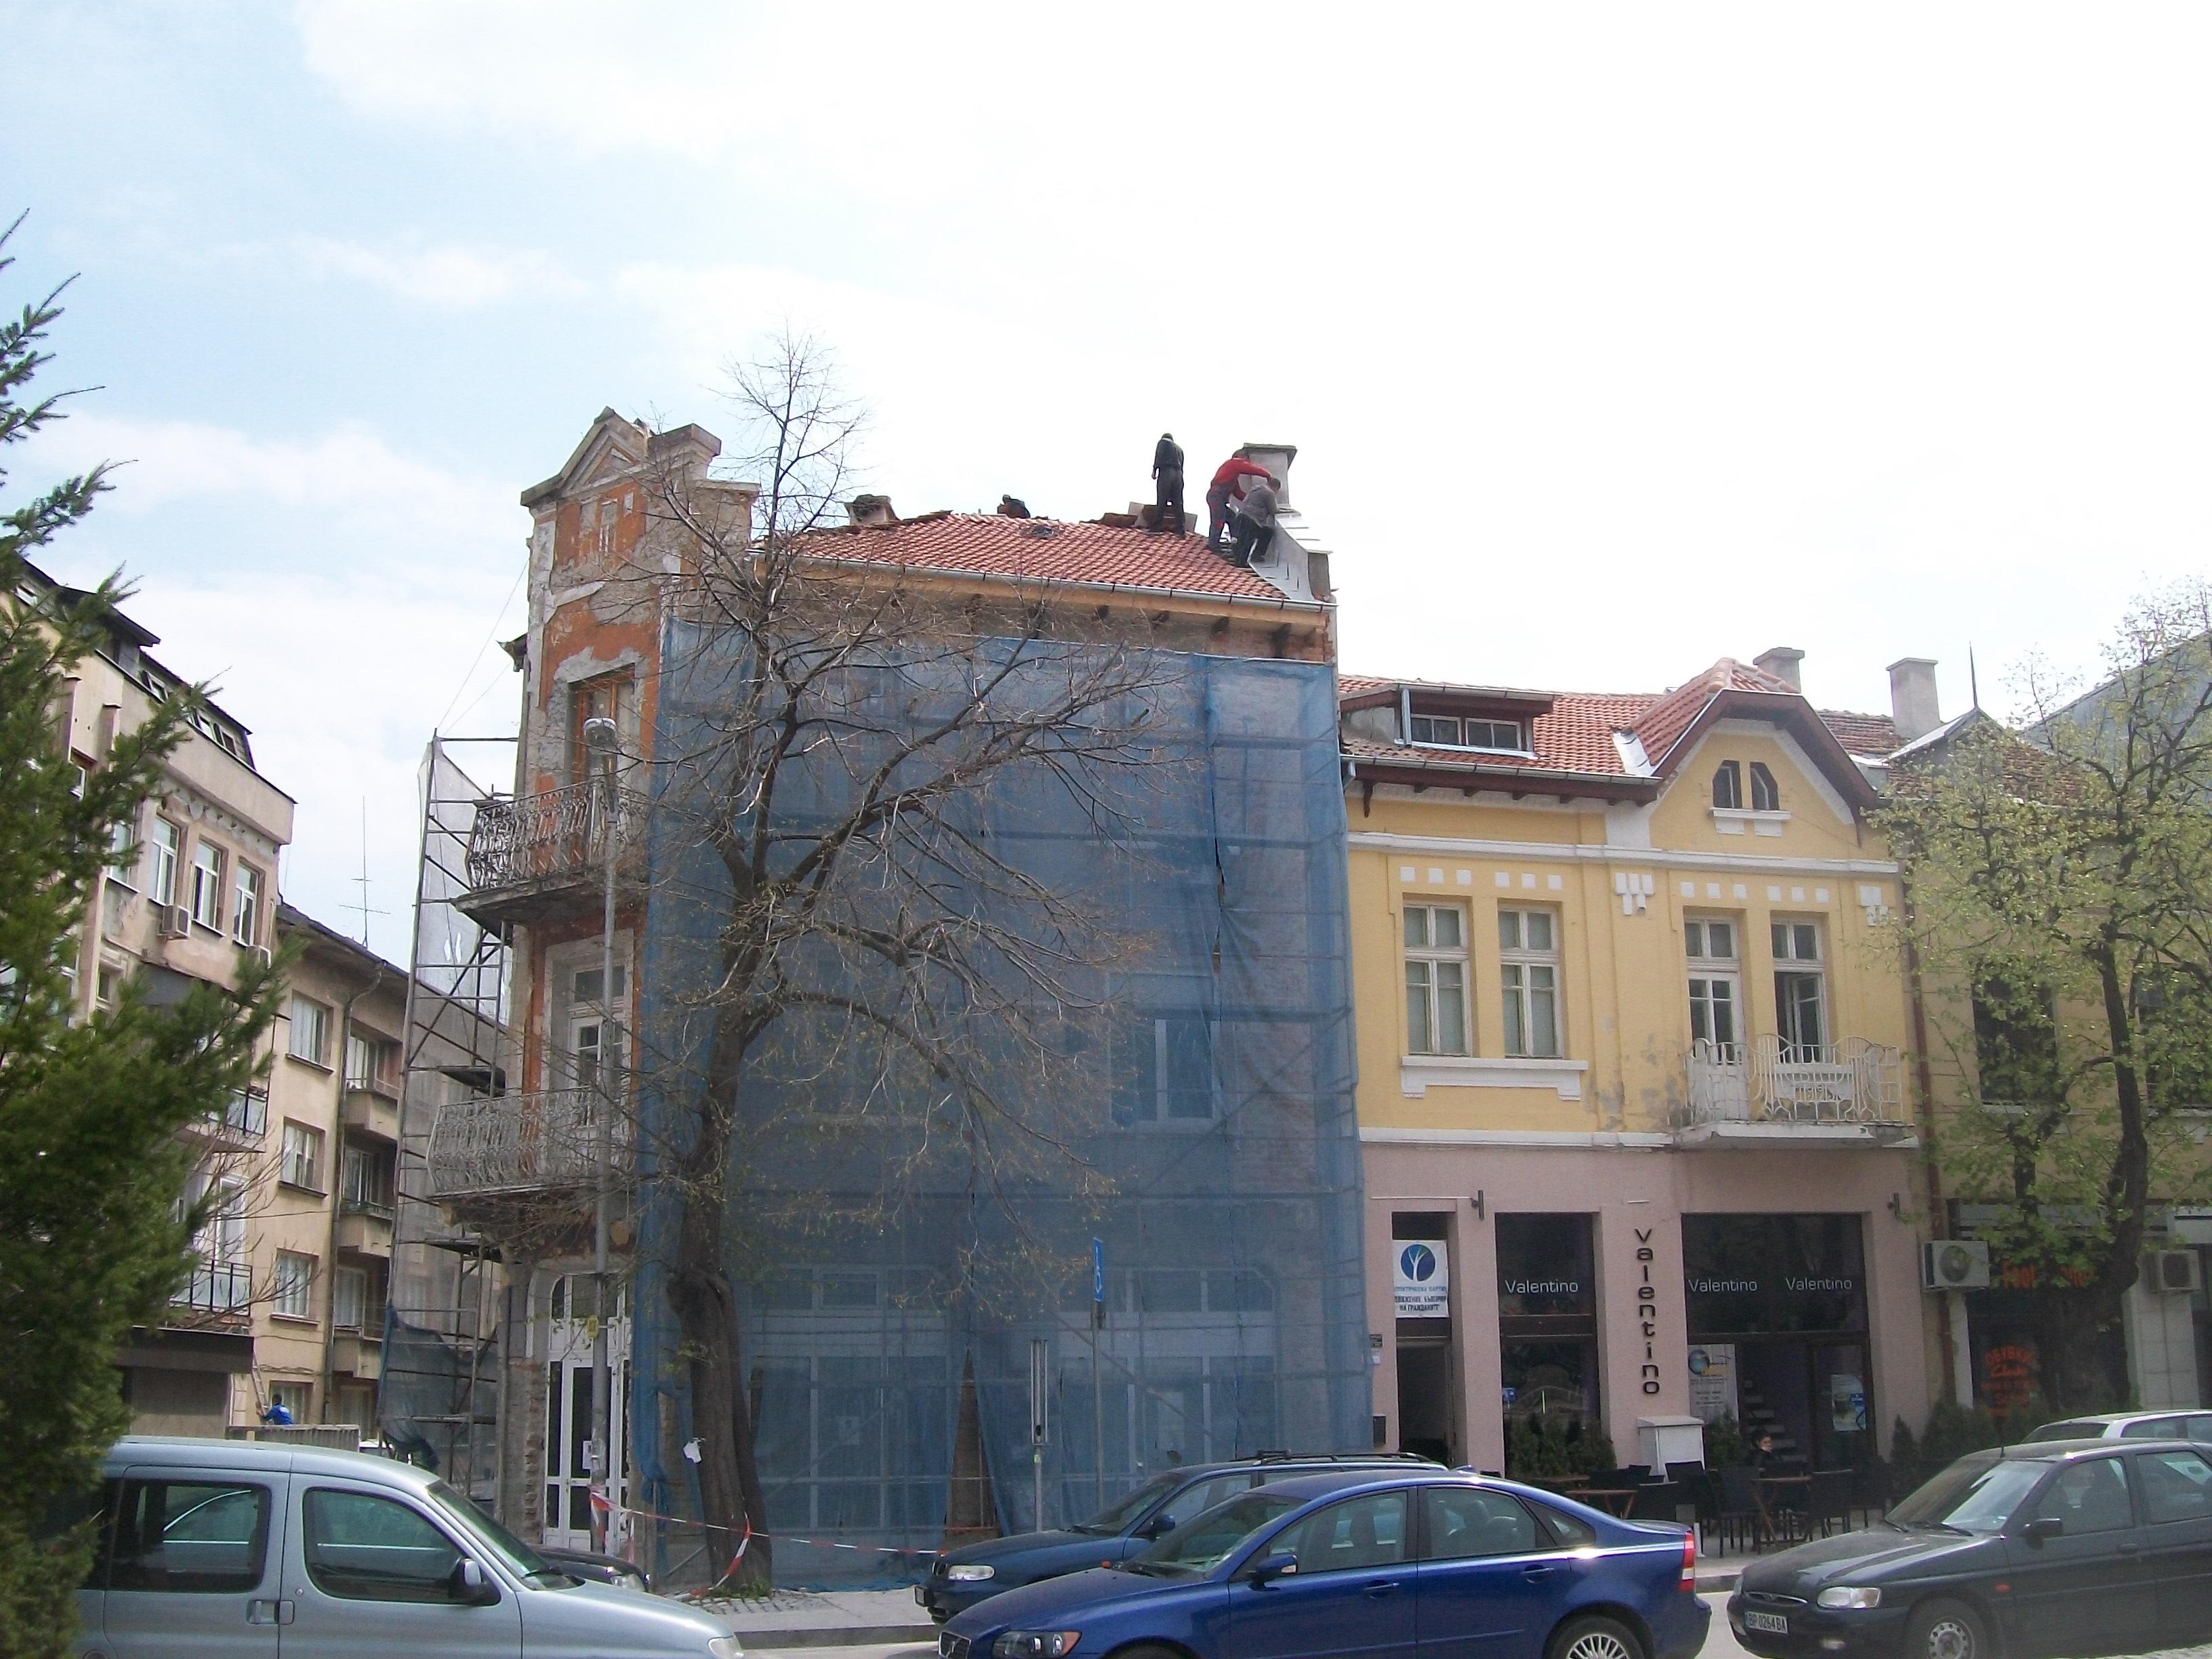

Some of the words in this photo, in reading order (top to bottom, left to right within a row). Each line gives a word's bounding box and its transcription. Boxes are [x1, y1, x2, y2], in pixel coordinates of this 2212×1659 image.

[1504, 1279, 1579, 1294] Valentino
[1688, 1278, 1758, 1292] Valentino
[1785, 1277, 1853, 1290] Valentino
